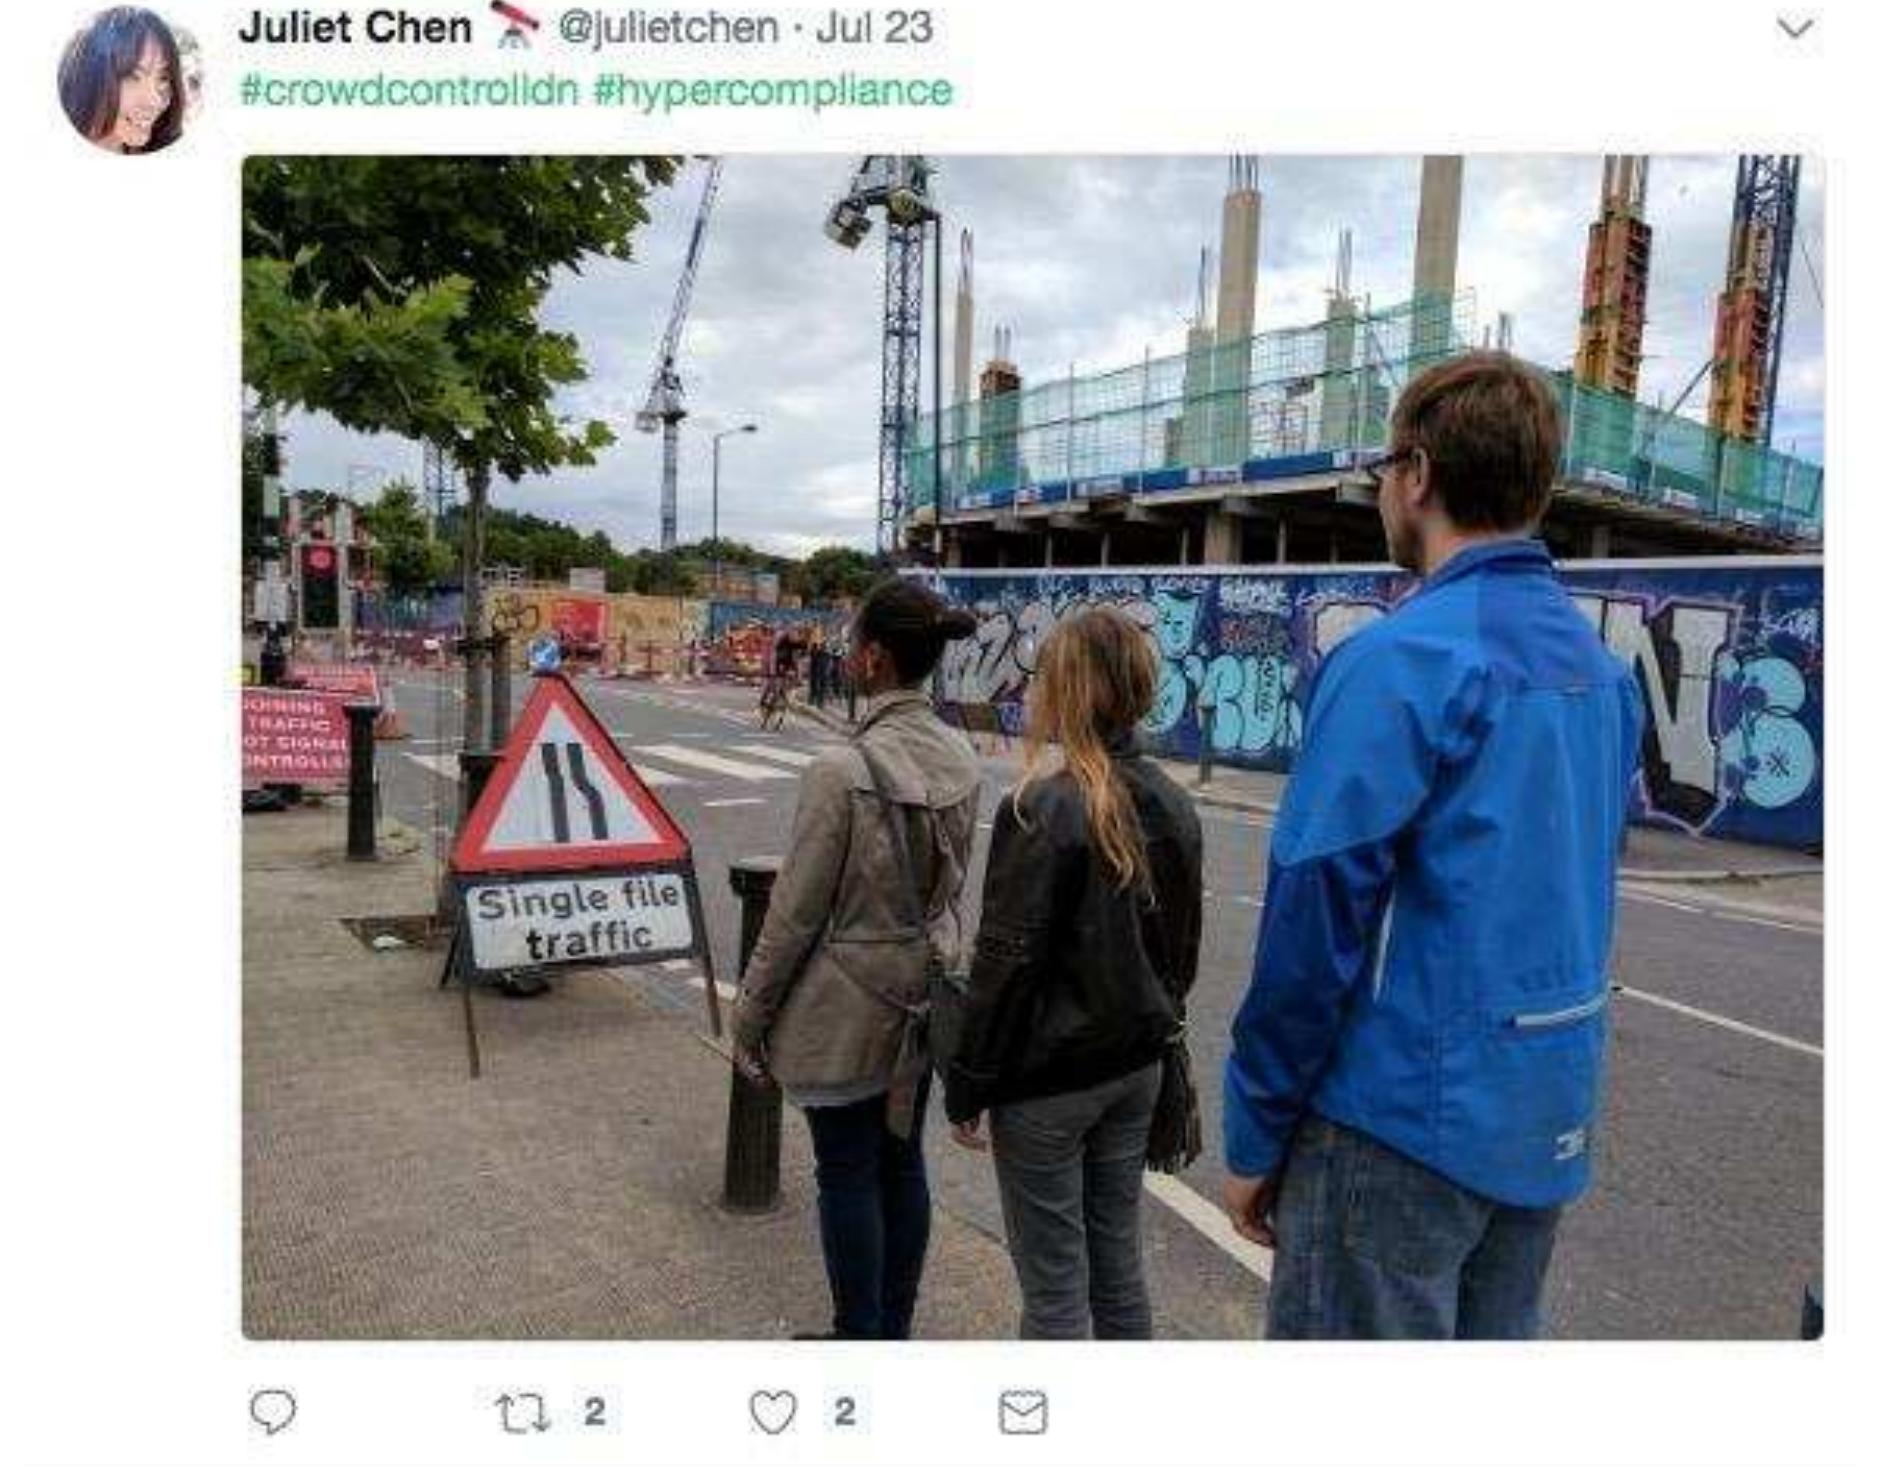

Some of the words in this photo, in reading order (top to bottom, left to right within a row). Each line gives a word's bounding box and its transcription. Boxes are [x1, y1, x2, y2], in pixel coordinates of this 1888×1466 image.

[250, 716, 331, 732] TRAFFIC
[477, 883, 609, 919] Single
[622, 880, 679, 910] file
[525, 921, 653, 960] traffic
